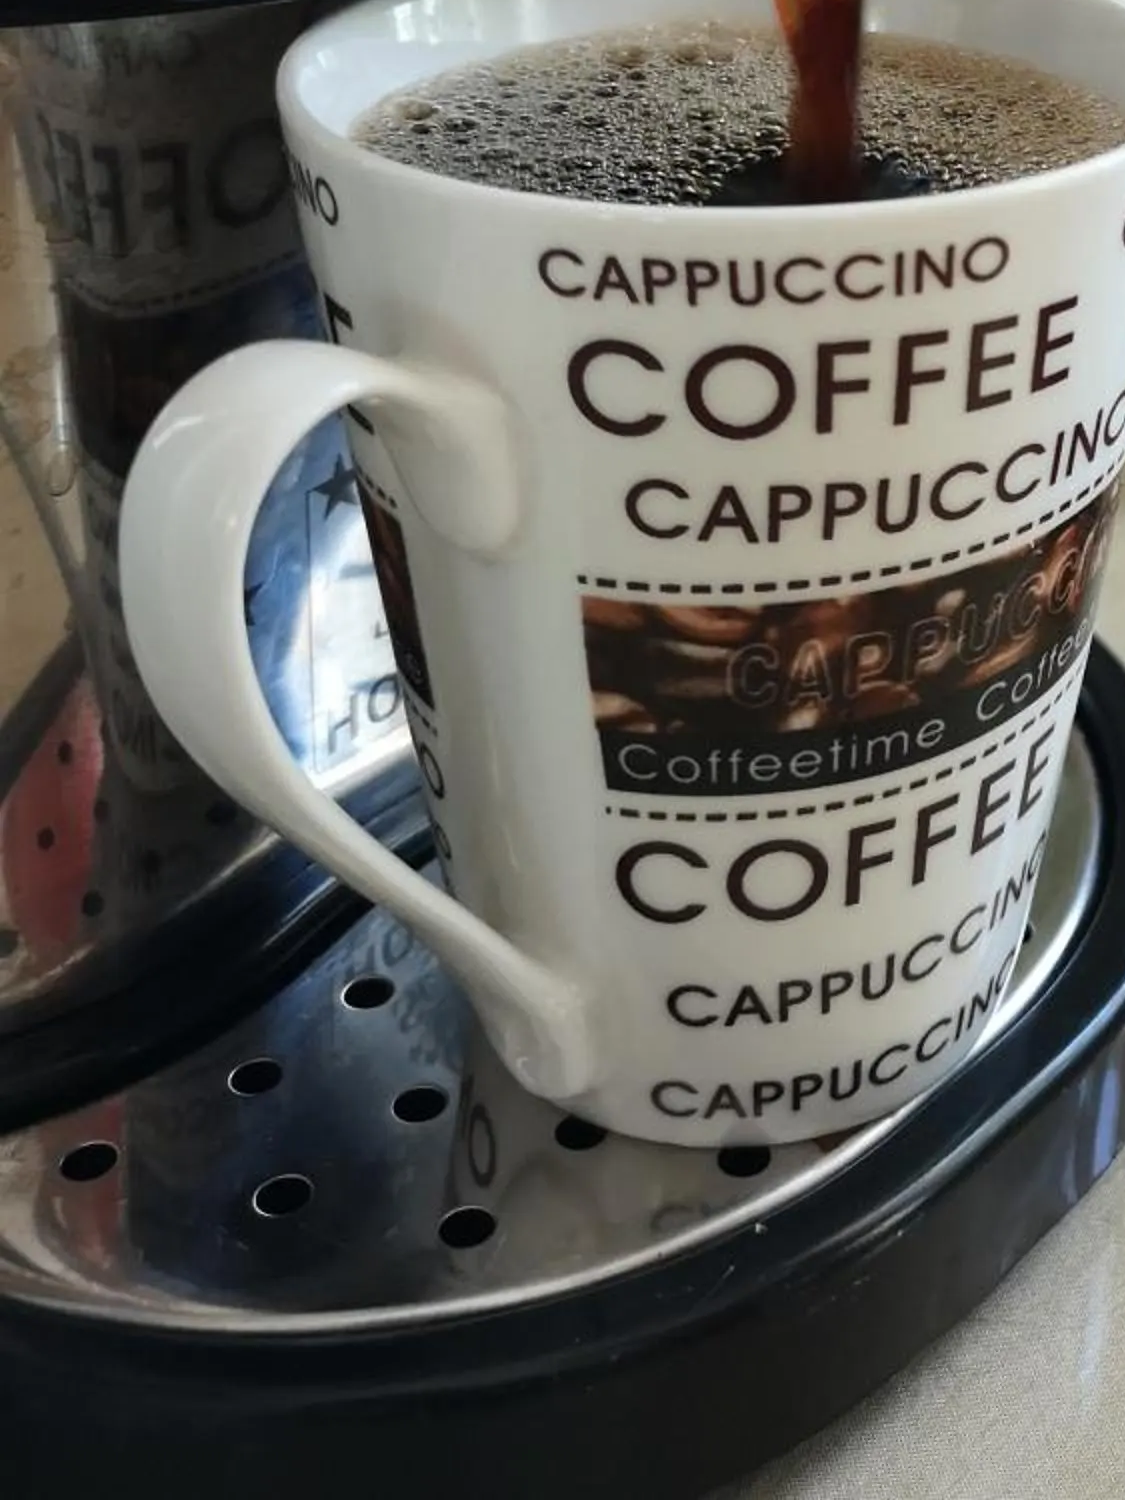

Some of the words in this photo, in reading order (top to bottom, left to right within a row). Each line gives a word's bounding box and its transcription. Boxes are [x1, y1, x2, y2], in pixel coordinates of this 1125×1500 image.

[537, 236, 1010, 306] CAPPUCCINO
[566, 295, 1080, 441] COFFEE
[617, 717, 946, 784] Coffeetime
[976, 617, 1094, 723] Coffee
[615, 725, 1057, 924] COFFEE
[667, 828, 1046, 1028] CAPPUCCINO
[650, 946, 1016, 1121] CAPPUCCINO
